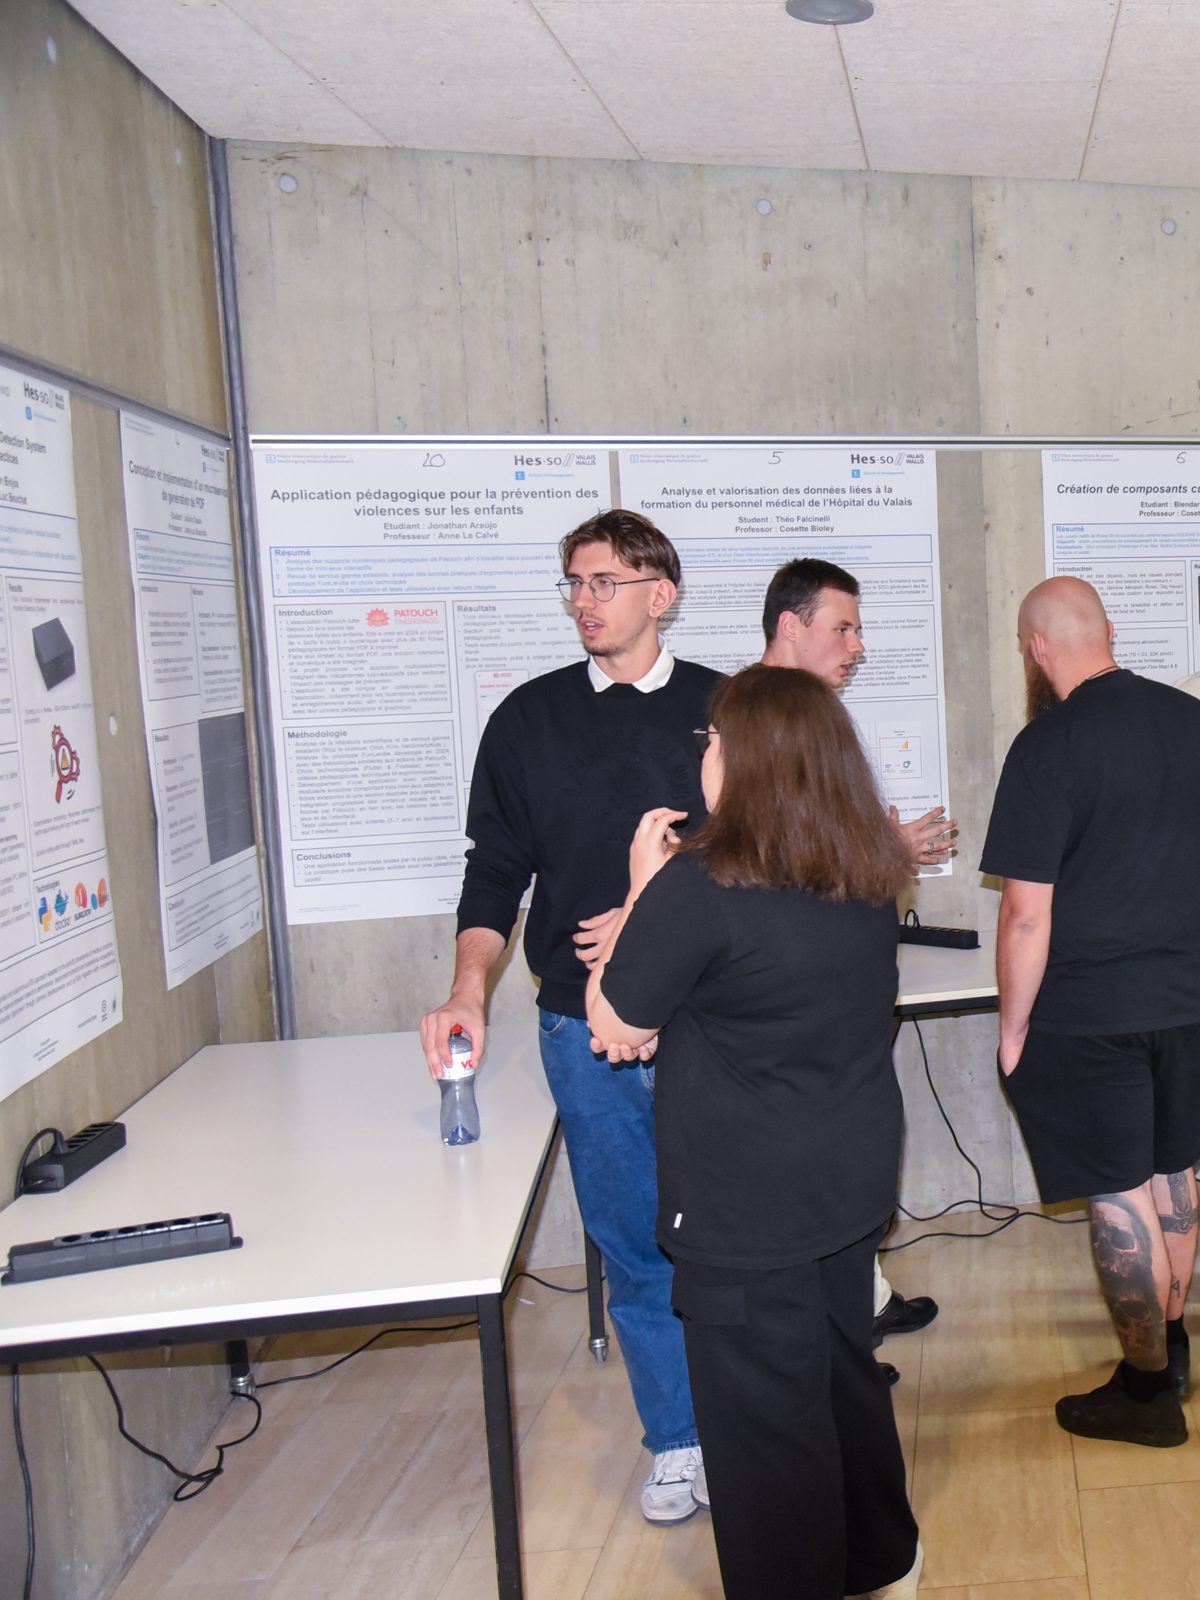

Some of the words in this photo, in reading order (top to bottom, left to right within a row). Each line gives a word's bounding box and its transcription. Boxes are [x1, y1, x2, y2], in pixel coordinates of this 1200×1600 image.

[25, 438, 47, 454] System
[768, 451, 784, 465] 5
[1176, 451, 1188, 464] 6
[270, 489, 351, 502] Application
[356, 488, 445, 502] pédagogique
[450, 491, 481, 501] pour
[485, 488, 496, 499] la
[501, 487, 571, 501] prévention
[575, 488, 598, 498] des
[661, 486, 703, 497] Analyse
[706, 487, 715, 495] et
[719, 486, 779, 495] valorisation
[782, 486, 800, 494] des
[803, 485, 846, 494] données
[849, 485, 872, 494] liées
[875, 485, 881, 493] à
[884, 485, 892, 493] la
[1057, 483, 1102, 494] Création
[1106, 484, 1119, 493] de
[1122, 485, 1187, 495] composants
[640, 499, 691, 508] formation
[694, 499, 707, 508] du
[711, 499, 762, 509] personnel
[765, 498, 804, 507] médical
[808, 498, 820, 507] de
[823, 498, 864, 508] l'Hôpital
[867, 498, 879, 506] du
[882, 497, 912, 506] Valais
[354, 505, 419, 516] violences
[424, 507, 446, 516] sur
[450, 504, 469, 515] les
[474, 504, 523, 515] enfants
[383, 522, 419, 530] Etudiant
[427, 521, 467, 529] Jonathan
[810, 524, 834, 533] Bioley
[383, 532, 430, 540] Professeur
[475, 531, 499, 539] Calvé
[274, 547, 311, 556] Résumé
[278, 608, 333, 617] Introduction
[394, 608, 438, 617] PATOUCH
[457, 603, 496, 613] Résultats
[287, 728, 347, 740] Méthodologie
[296, 851, 351, 862] Conclusions
